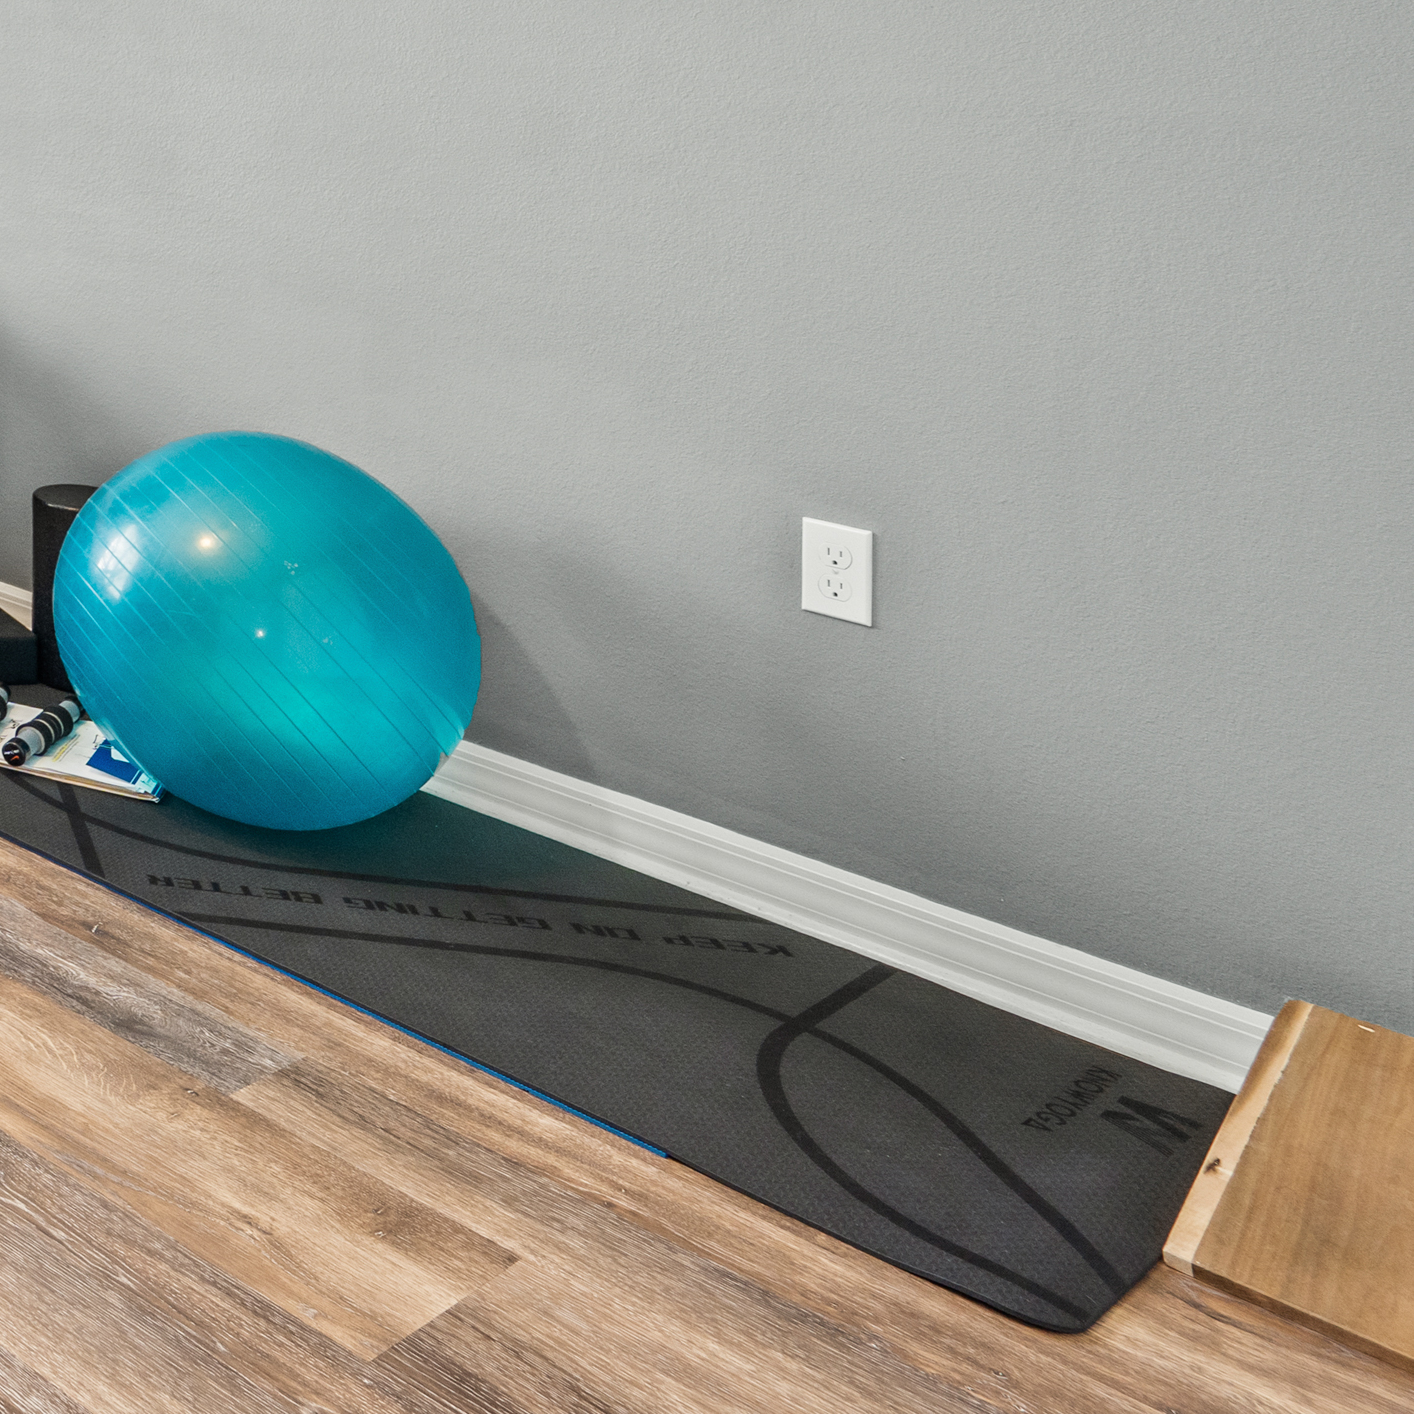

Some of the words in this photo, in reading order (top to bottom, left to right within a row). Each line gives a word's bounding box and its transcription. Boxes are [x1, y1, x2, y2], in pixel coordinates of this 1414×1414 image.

[145, 873, 324, 905] BETTER
[341, 895, 553, 931] GETTING
[569, 921, 642, 942] ON
[662, 933, 795, 958] KEEP
[1022, 1065, 1121, 1132] KNOWYOGA
